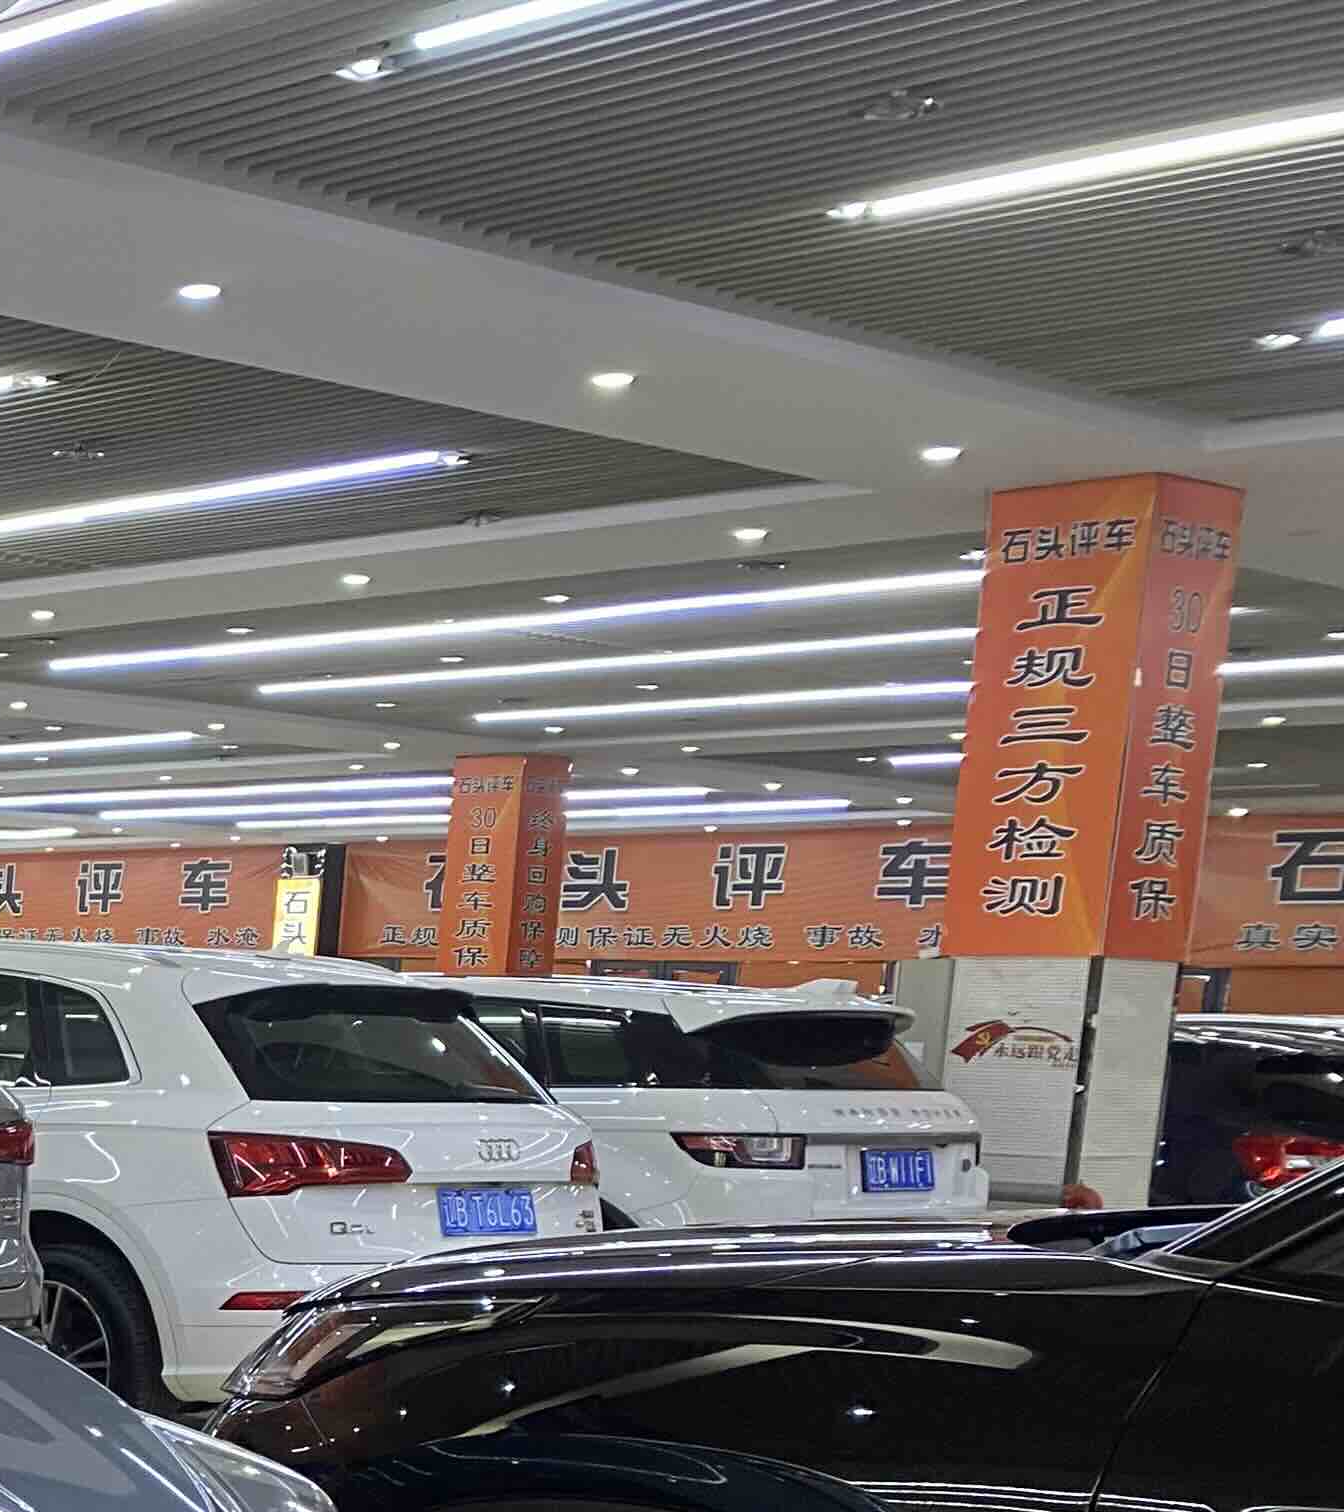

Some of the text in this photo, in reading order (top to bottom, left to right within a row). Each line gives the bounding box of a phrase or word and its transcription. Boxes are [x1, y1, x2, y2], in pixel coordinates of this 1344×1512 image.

[1001, 518, 1137, 564] 石头评车
[981, 584, 1105, 917] 正规三方检测
[806, 924, 883, 949] 事故
